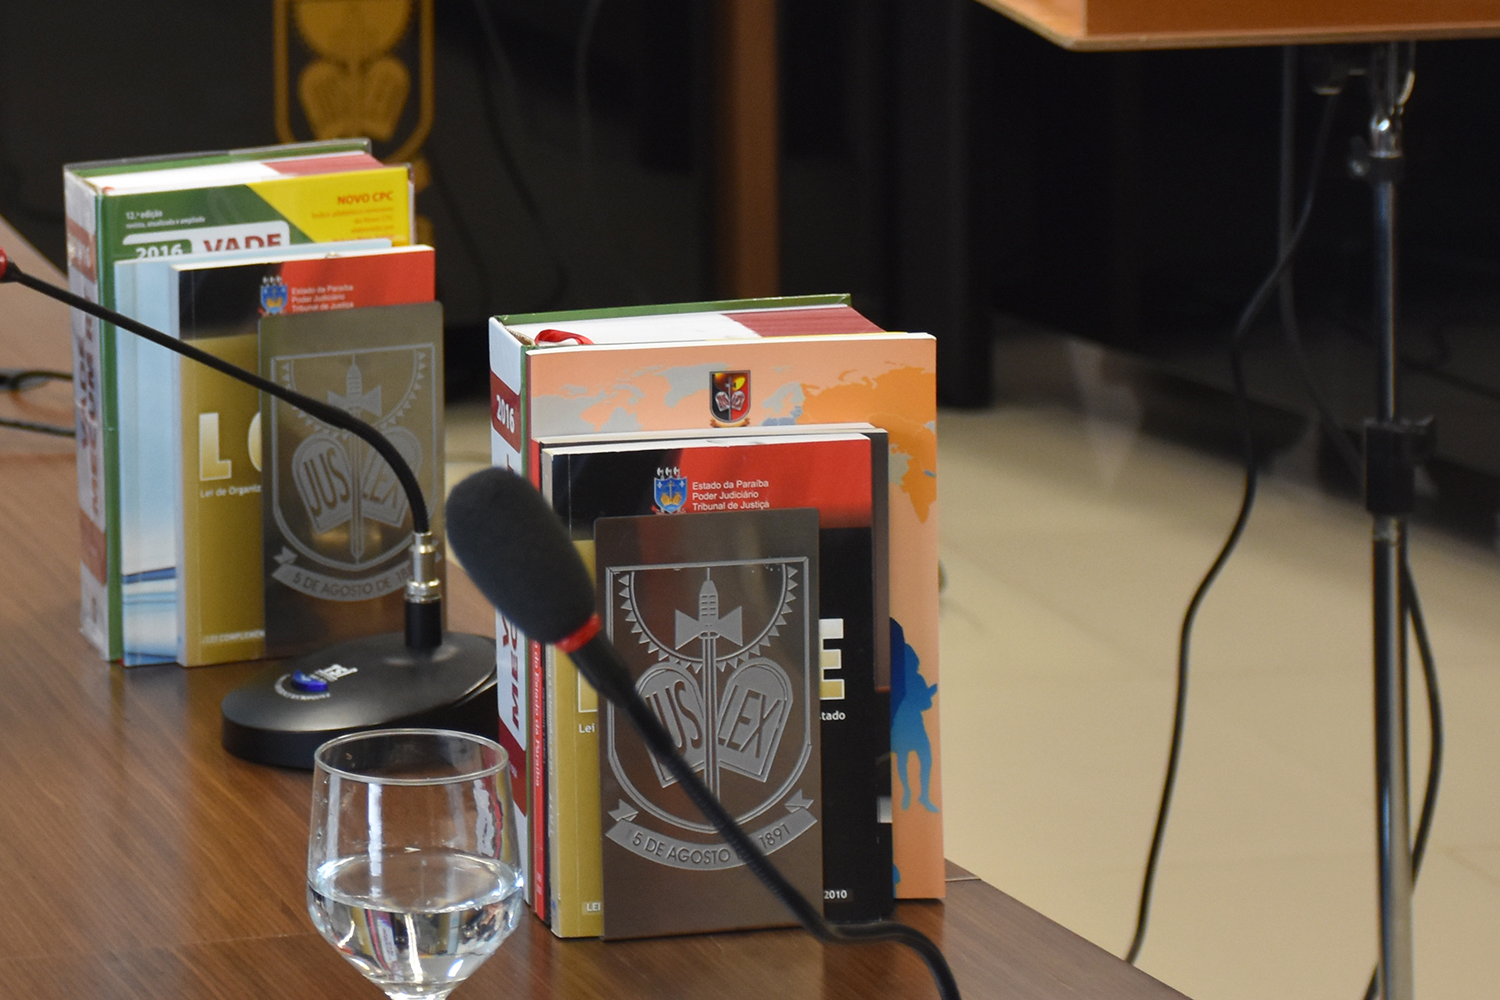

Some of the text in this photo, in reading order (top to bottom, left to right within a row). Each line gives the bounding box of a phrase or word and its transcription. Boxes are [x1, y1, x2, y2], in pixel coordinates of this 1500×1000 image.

[337, 189, 394, 205] NOVO CPC
[136, 243, 184, 260] 2016
[496, 394, 516, 435] 2016
[692, 479, 769, 490] Estado da Paraíba
[692, 490, 759, 501] Poder Judiciário
[692, 502, 726, 511] Tribunal
[740, 500, 770, 510] Justiça
[645, 679, 781, 759] US LEX
[819, 710, 846, 722] tado
[579, 723, 596, 734] Lei
[632, 822, 791, 865] 5 DE AGOSTO 1891
[823, 888, 848, 900] 2010
